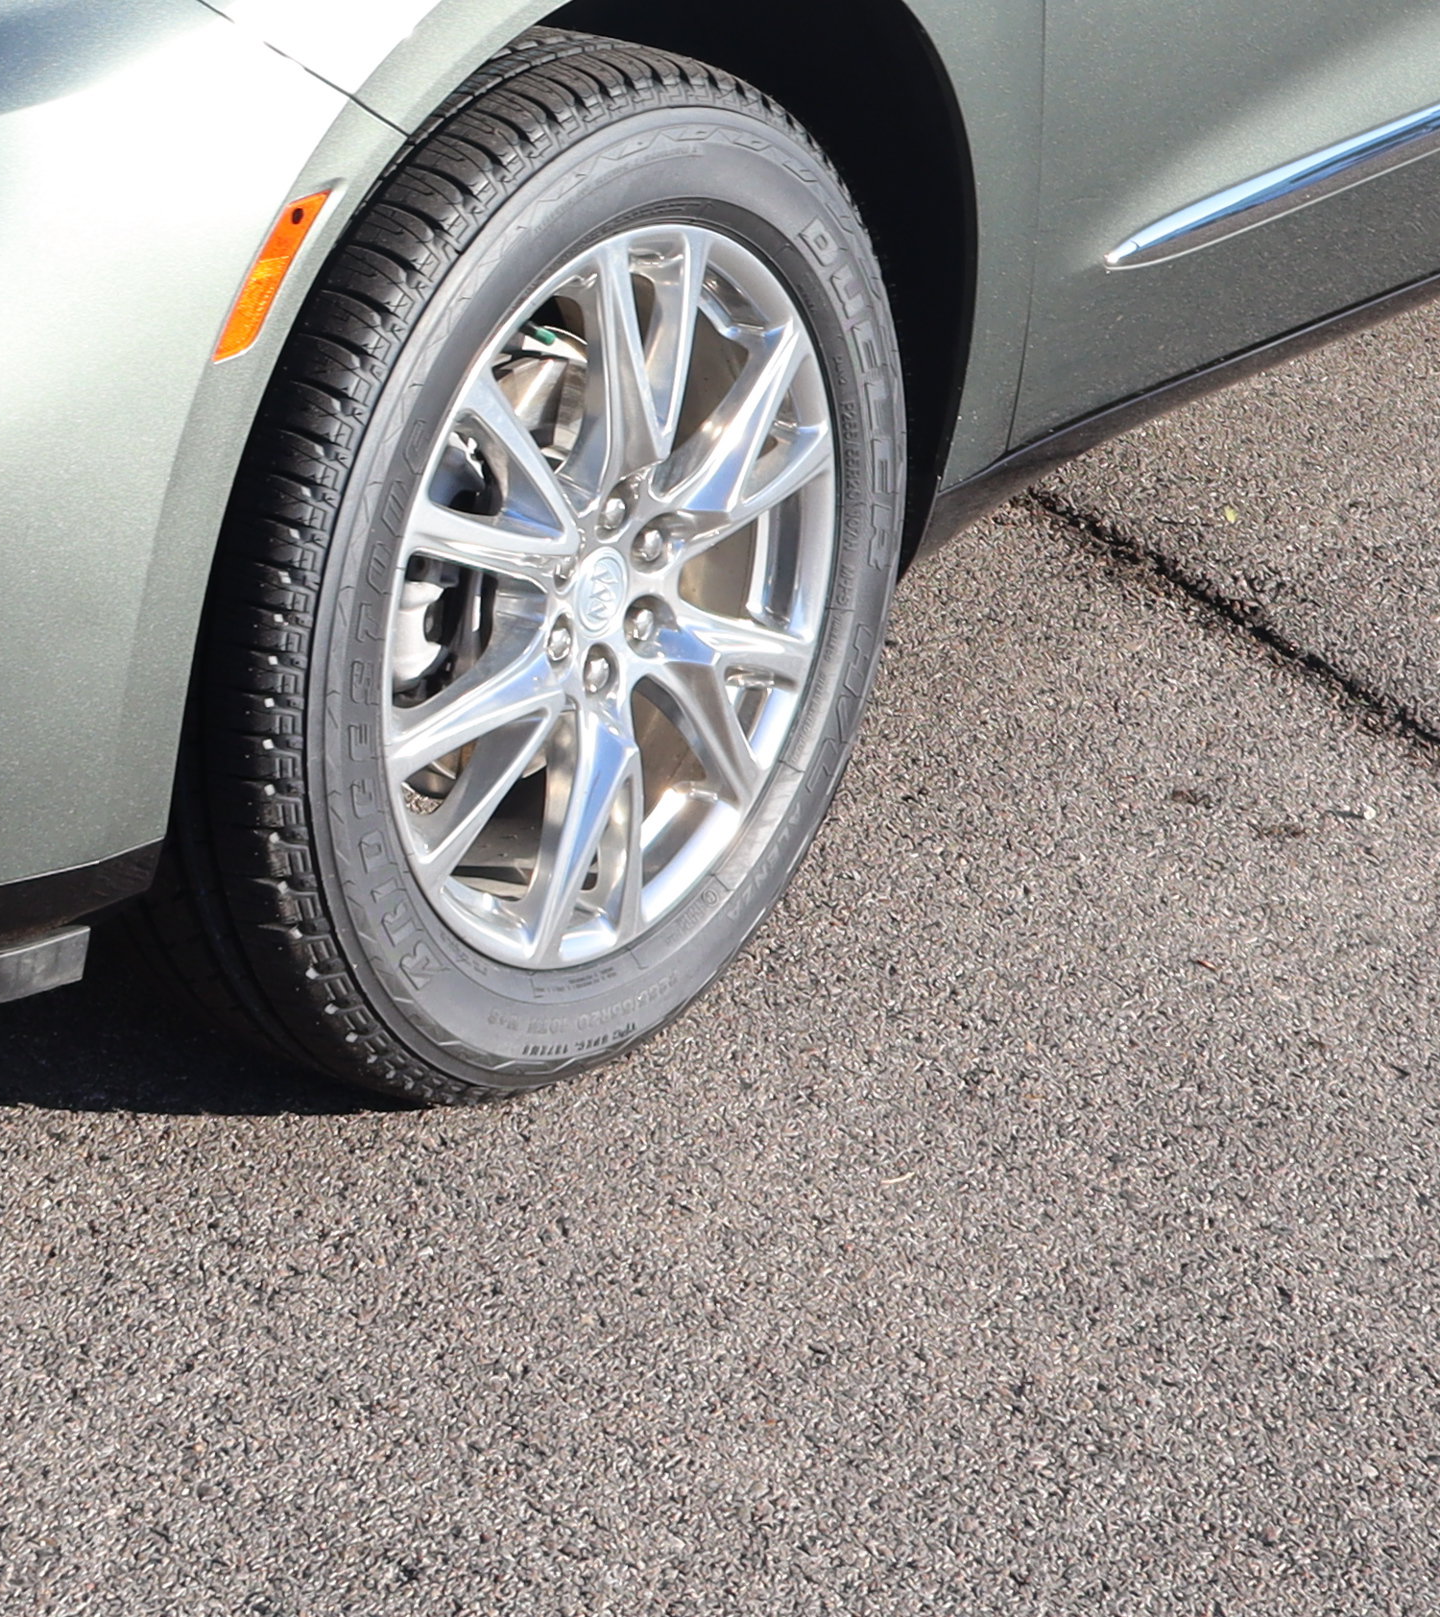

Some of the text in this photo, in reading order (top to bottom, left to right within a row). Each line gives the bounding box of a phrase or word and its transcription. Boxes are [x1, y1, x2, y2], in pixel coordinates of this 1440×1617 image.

[797, 216, 893, 571] DUELER
[348, 418, 451, 991] BRIDGESTONE
[726, 801, 801, 921] ALENZA
